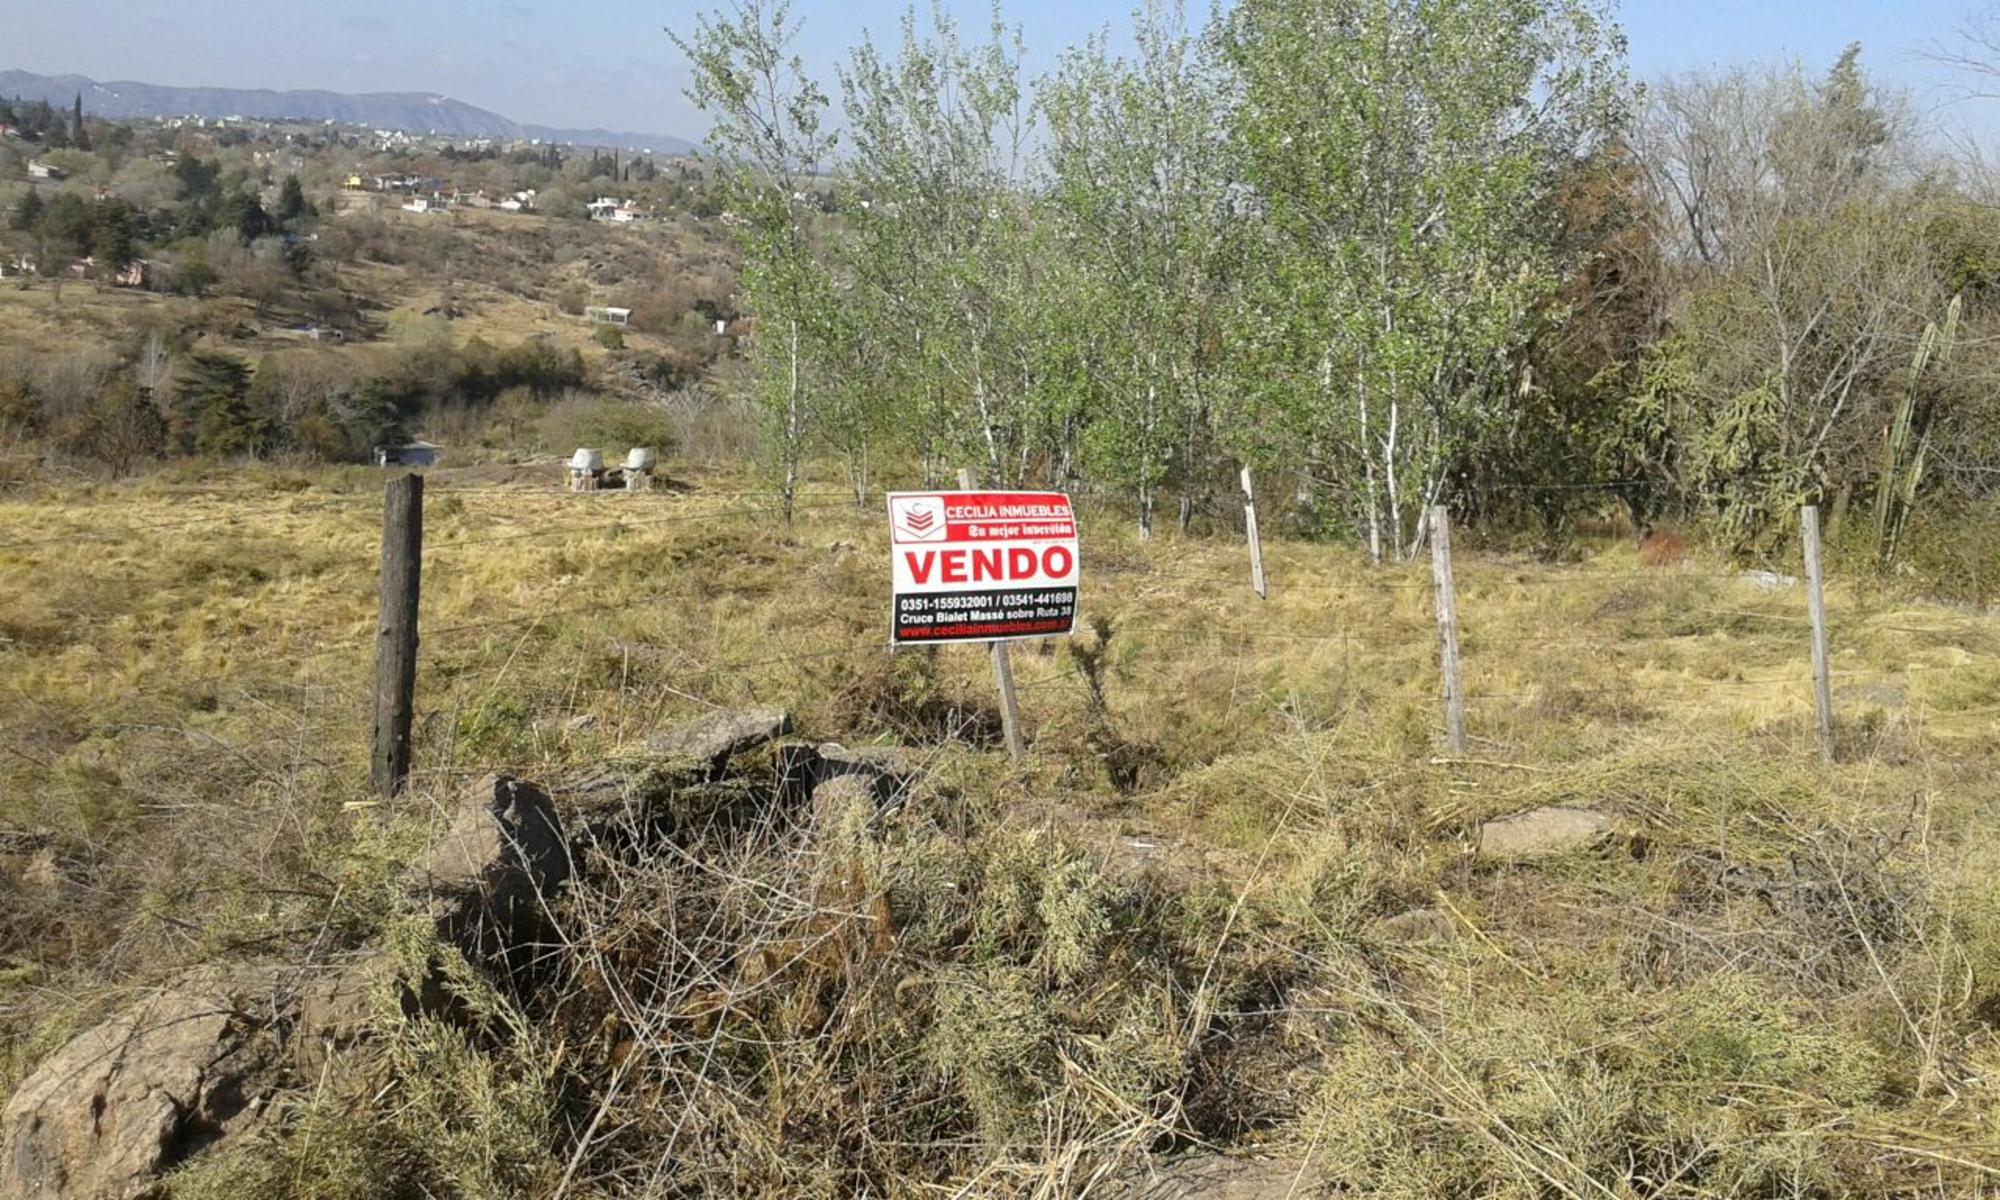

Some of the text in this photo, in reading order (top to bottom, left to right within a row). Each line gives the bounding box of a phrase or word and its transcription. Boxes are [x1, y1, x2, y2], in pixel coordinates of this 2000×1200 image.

[946, 505, 1070, 518] CECILIA INMUEBLES
[989, 525, 1019, 538] mejor
[905, 546, 1073, 584] VENDO
[901, 595, 992, 610] 0351-155932001
[1002, 592, 1073, 606] 03541-441698
[900, 606, 1072, 624] Cruce Bialet Massé sobre Ruta 38
